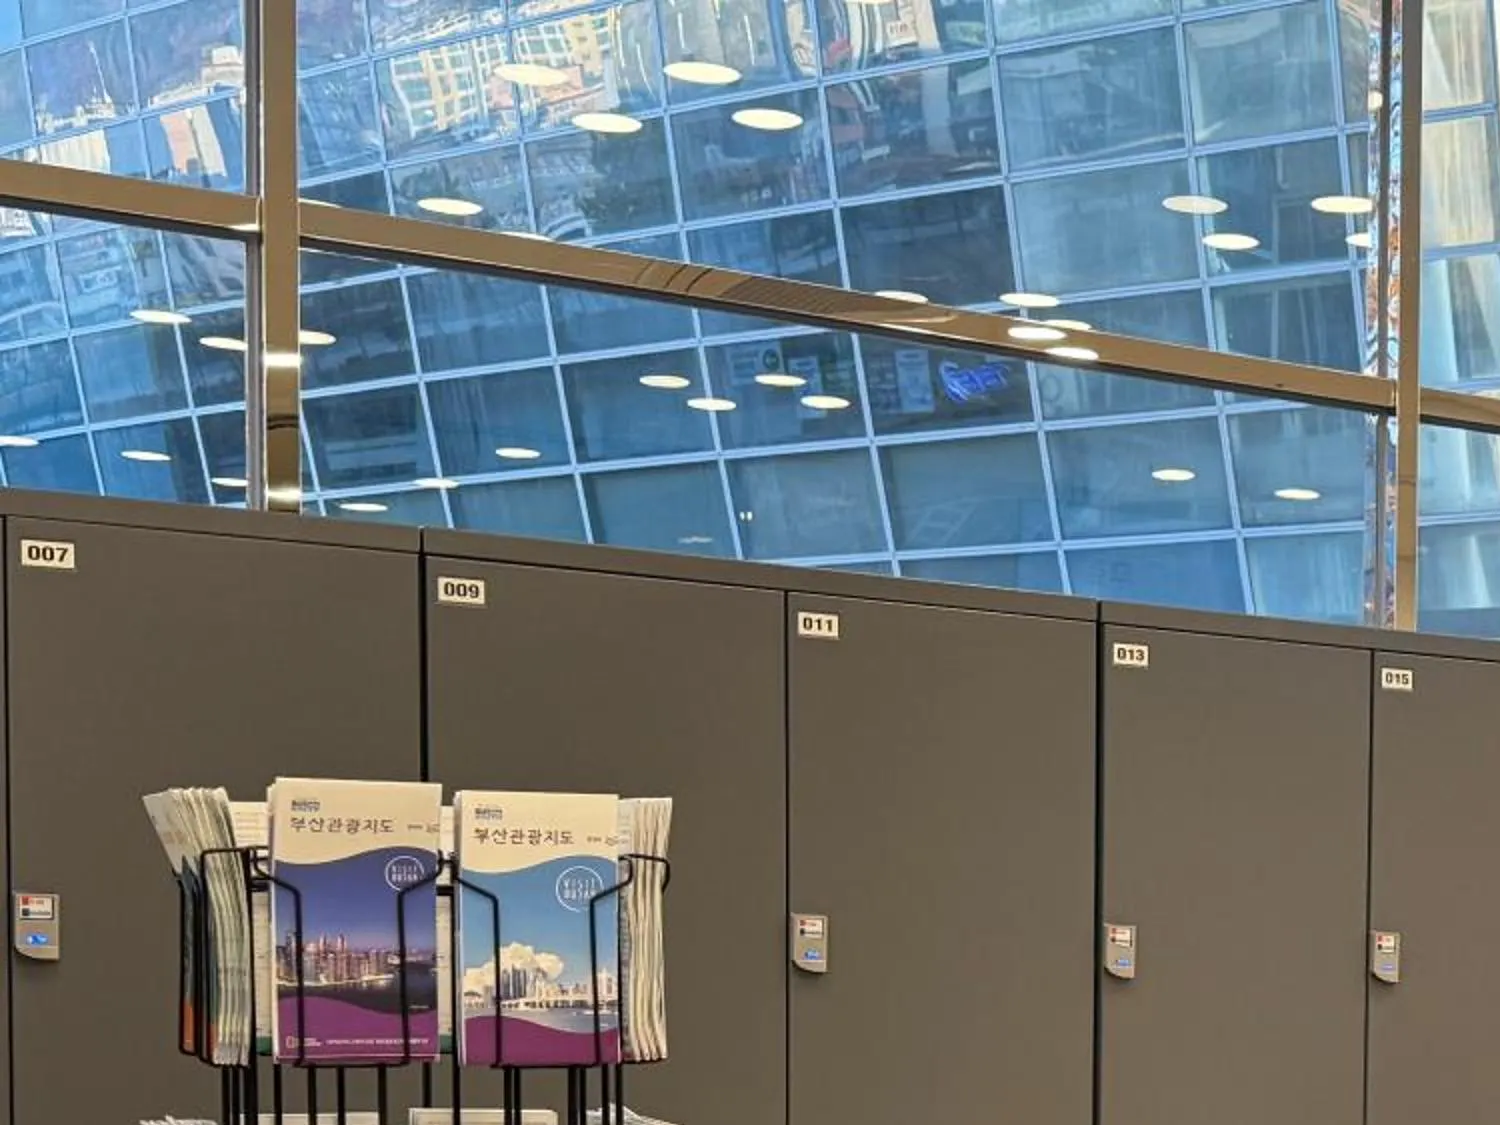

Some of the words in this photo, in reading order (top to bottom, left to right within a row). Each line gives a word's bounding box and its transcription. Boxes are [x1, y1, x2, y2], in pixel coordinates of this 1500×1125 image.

[27, 544, 69, 564] 007
[443, 581, 481, 600] 009
[802, 616, 833, 633] 011
[1116, 647, 1146, 663] 013
[1385, 671, 1410, 686] 015
[291, 816, 394, 834] 부산관광지도
[474, 828, 574, 845] 부산관광지도
